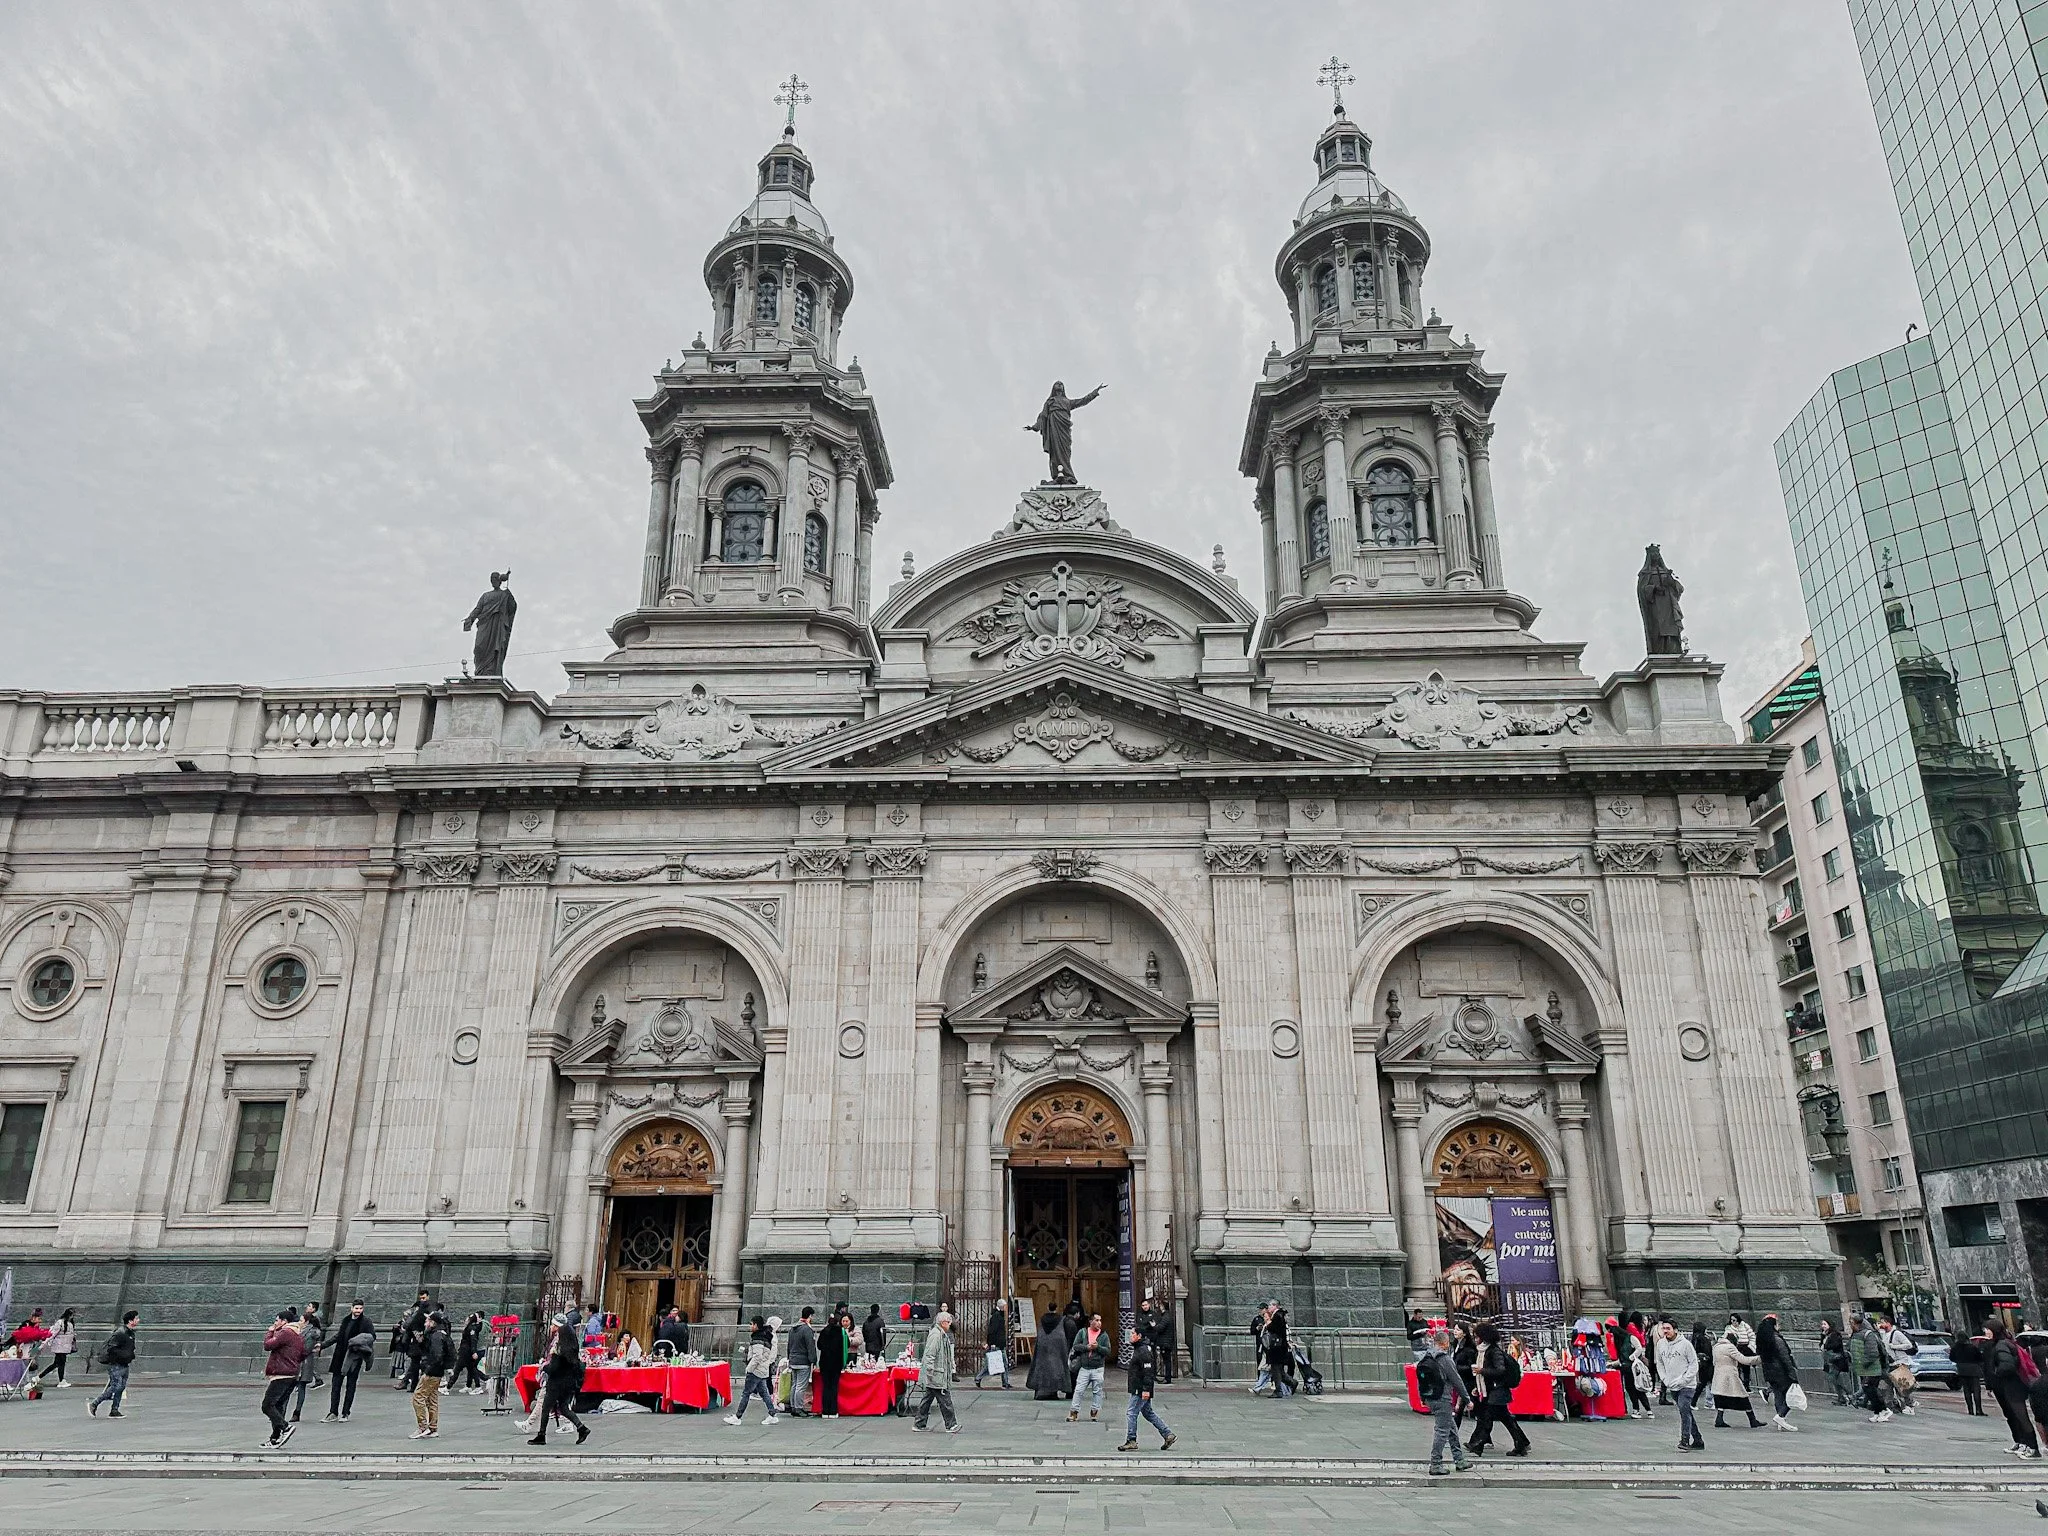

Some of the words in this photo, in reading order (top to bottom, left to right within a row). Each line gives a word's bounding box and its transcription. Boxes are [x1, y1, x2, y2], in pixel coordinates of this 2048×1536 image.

[1511, 1207, 1526, 1216] Me
[1528, 1206, 1549, 1216] amó
[1532, 1220, 1539, 1229] y
[1540, 1220, 1551, 1228] se
[1514, 1229, 1552, 1241] entregó
[1499, 1242, 1530, 1260] por
[1533, 1239, 1555, 1257] mí
